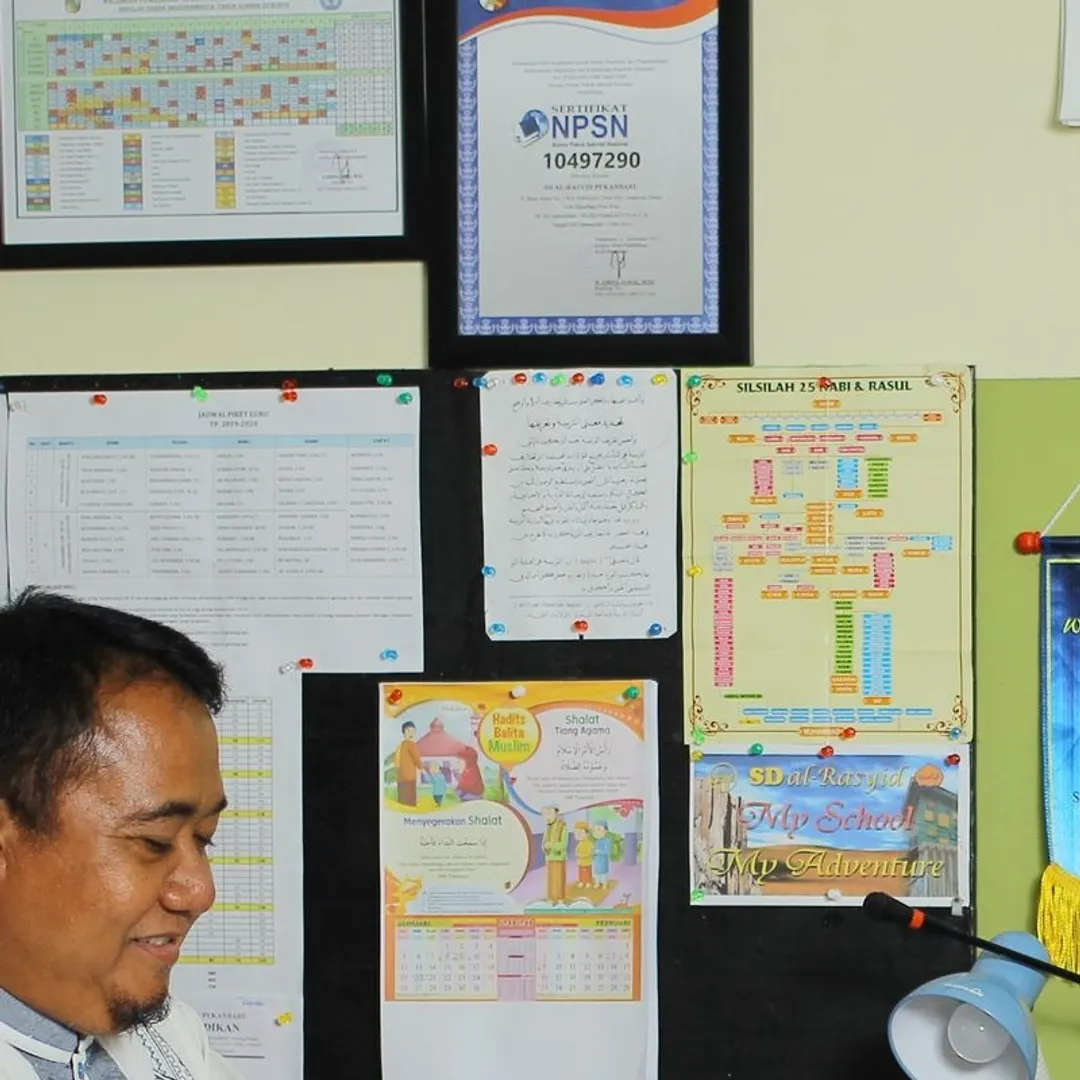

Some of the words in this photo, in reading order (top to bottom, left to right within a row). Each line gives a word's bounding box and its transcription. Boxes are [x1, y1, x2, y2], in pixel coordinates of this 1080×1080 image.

[551, 104, 628, 113] SERTIFIKAT
[551, 114, 628, 139] NPSN
[543, 151, 641, 169] 10497290
[736, 381, 795, 393] SILSILAH
[799, 381, 816, 393] 25
[854, 381, 865, 391] &
[868, 380, 913, 391] RASUL
[492, 713, 526, 725] Hadits
[565, 714, 600, 725] Shalat
[494, 726, 525, 738] Balita
[554, 726, 578, 737] Tiang
[580, 726, 611, 737] Agama
[488, 740, 531, 753] Muslim
[749, 766, 785, 786] SD
[787, 764, 909, 794] al-Rasyid
[403, 816, 467, 828] Menyegerakan
[467, 814, 503, 826] Shalat
[737, 801, 808, 839] My
[816, 800, 917, 834] School
[707, 848, 779, 886] My
[785, 847, 945, 879] Adventure
[203, 1023, 240, 1032] DIKAN
